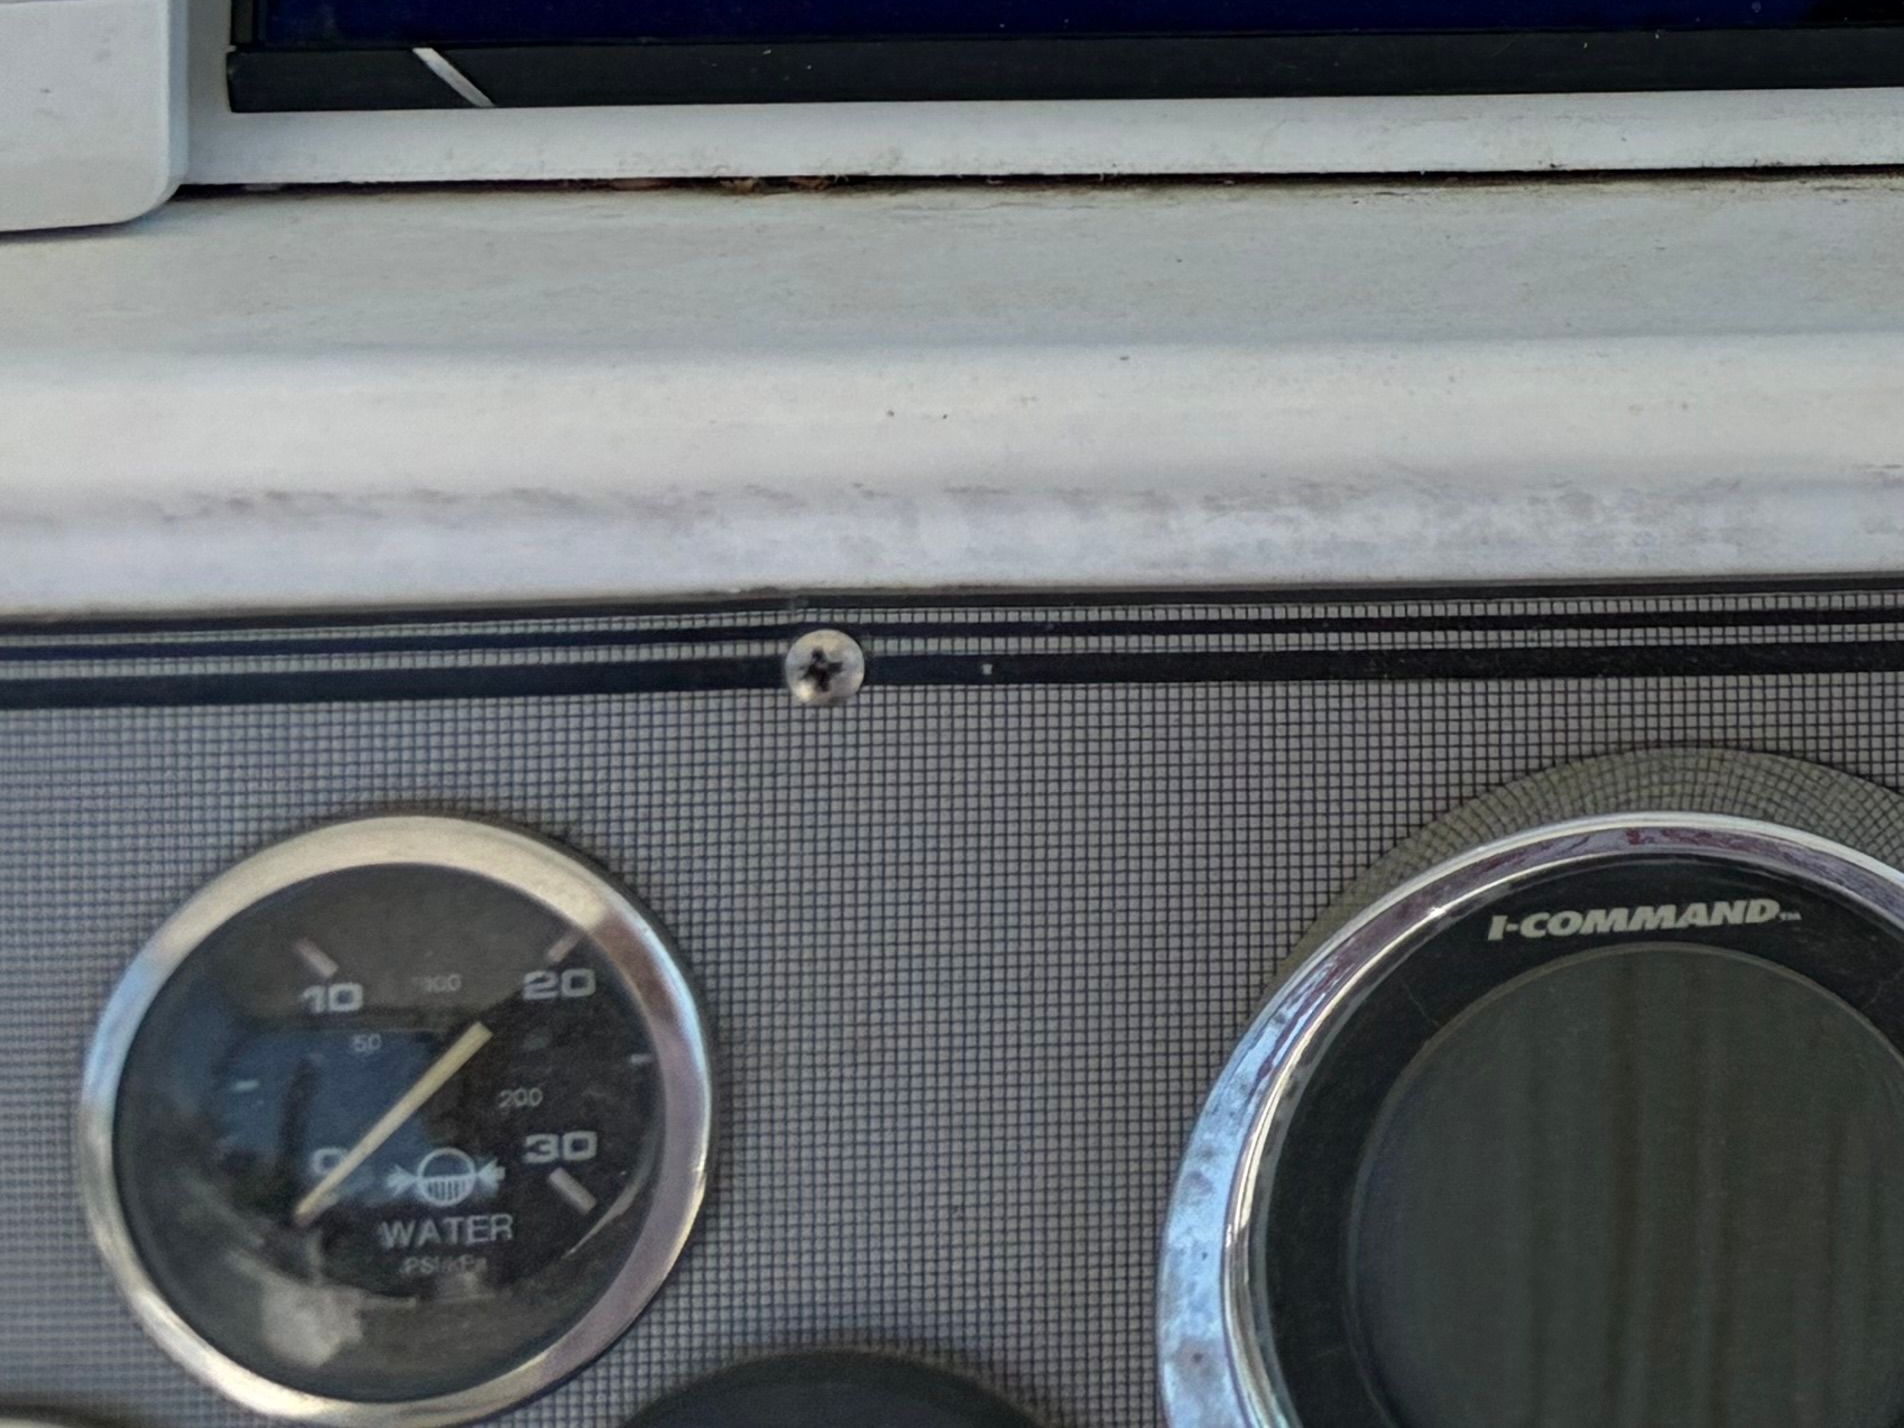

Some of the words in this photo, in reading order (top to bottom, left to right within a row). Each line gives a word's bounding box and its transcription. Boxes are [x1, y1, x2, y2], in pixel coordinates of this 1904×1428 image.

[303, 982, 363, 1013] 10
[523, 968, 596, 1001] 20
[353, 1033, 382, 1053] 50
[499, 1087, 544, 1108] 200
[523, 1130, 598, 1164] 30
[380, 1213, 514, 1250] WATER
